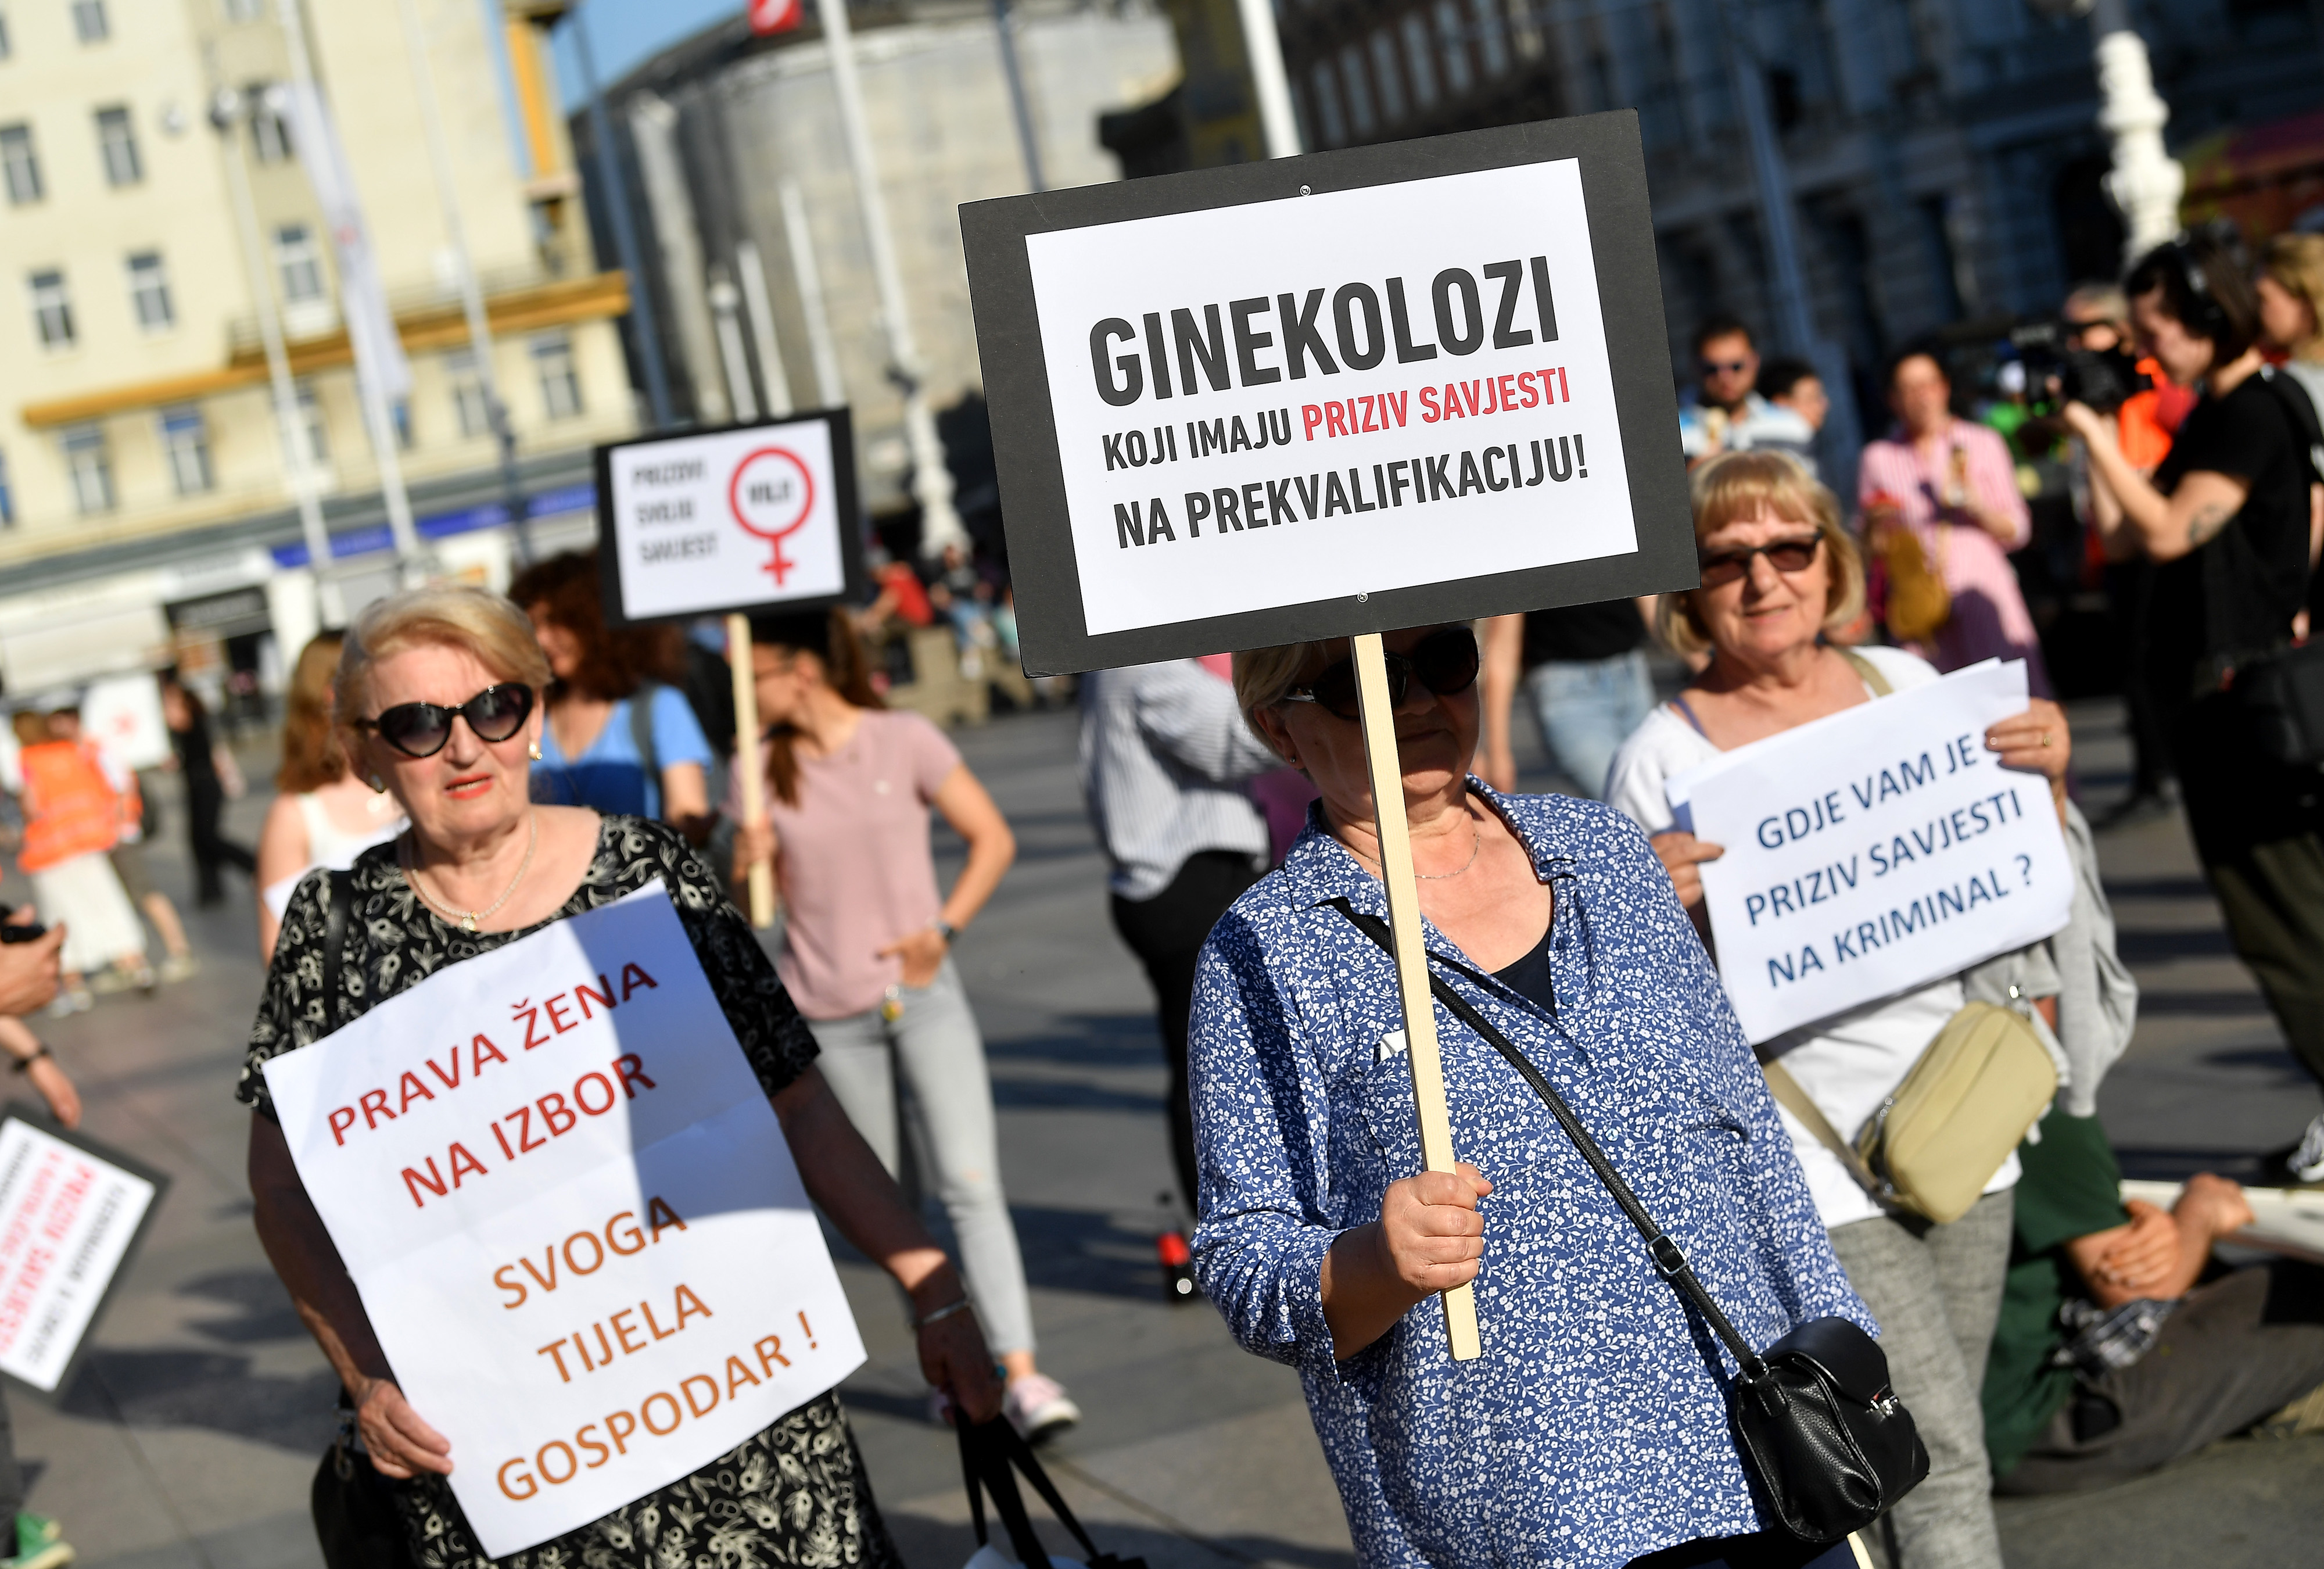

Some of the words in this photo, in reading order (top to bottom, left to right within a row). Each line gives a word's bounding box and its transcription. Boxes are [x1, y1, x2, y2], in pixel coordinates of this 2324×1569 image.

[1090, 256, 1558, 406] GINEKOLOZI
[1102, 425, 1177, 471] KOJI
[1186, 409, 1291, 458] IMAJU
[1301, 391, 1407, 441] PRIZIV
[1419, 367, 1569, 422] SAVJESTI
[1114, 498, 1176, 549] NA
[1185, 434, 1587, 538] PREKVALIFIKACIJU!
[1757, 791, 1845, 850] GDJE
[1851, 753, 1935, 809] VAM
[1946, 735, 1977, 774] JE
[1745, 855, 1857, 926] PRIZIV
[1869, 789, 2021, 877] SAVJESTI
[1768, 945, 1824, 987] NA
[1834, 870, 2009, 963] KRIMINAL
[328, 1034, 508, 1147] PRAVA
[511, 962, 658, 1051] ŽENA
[401, 1142, 488, 1208] NA
[491, 1053, 657, 1161] IZBOR
[493, 1196, 687, 1310] SVOGA
[537, 1284, 713, 1383] TIJELA
[497, 1335, 791, 1502] GOSPODAR
